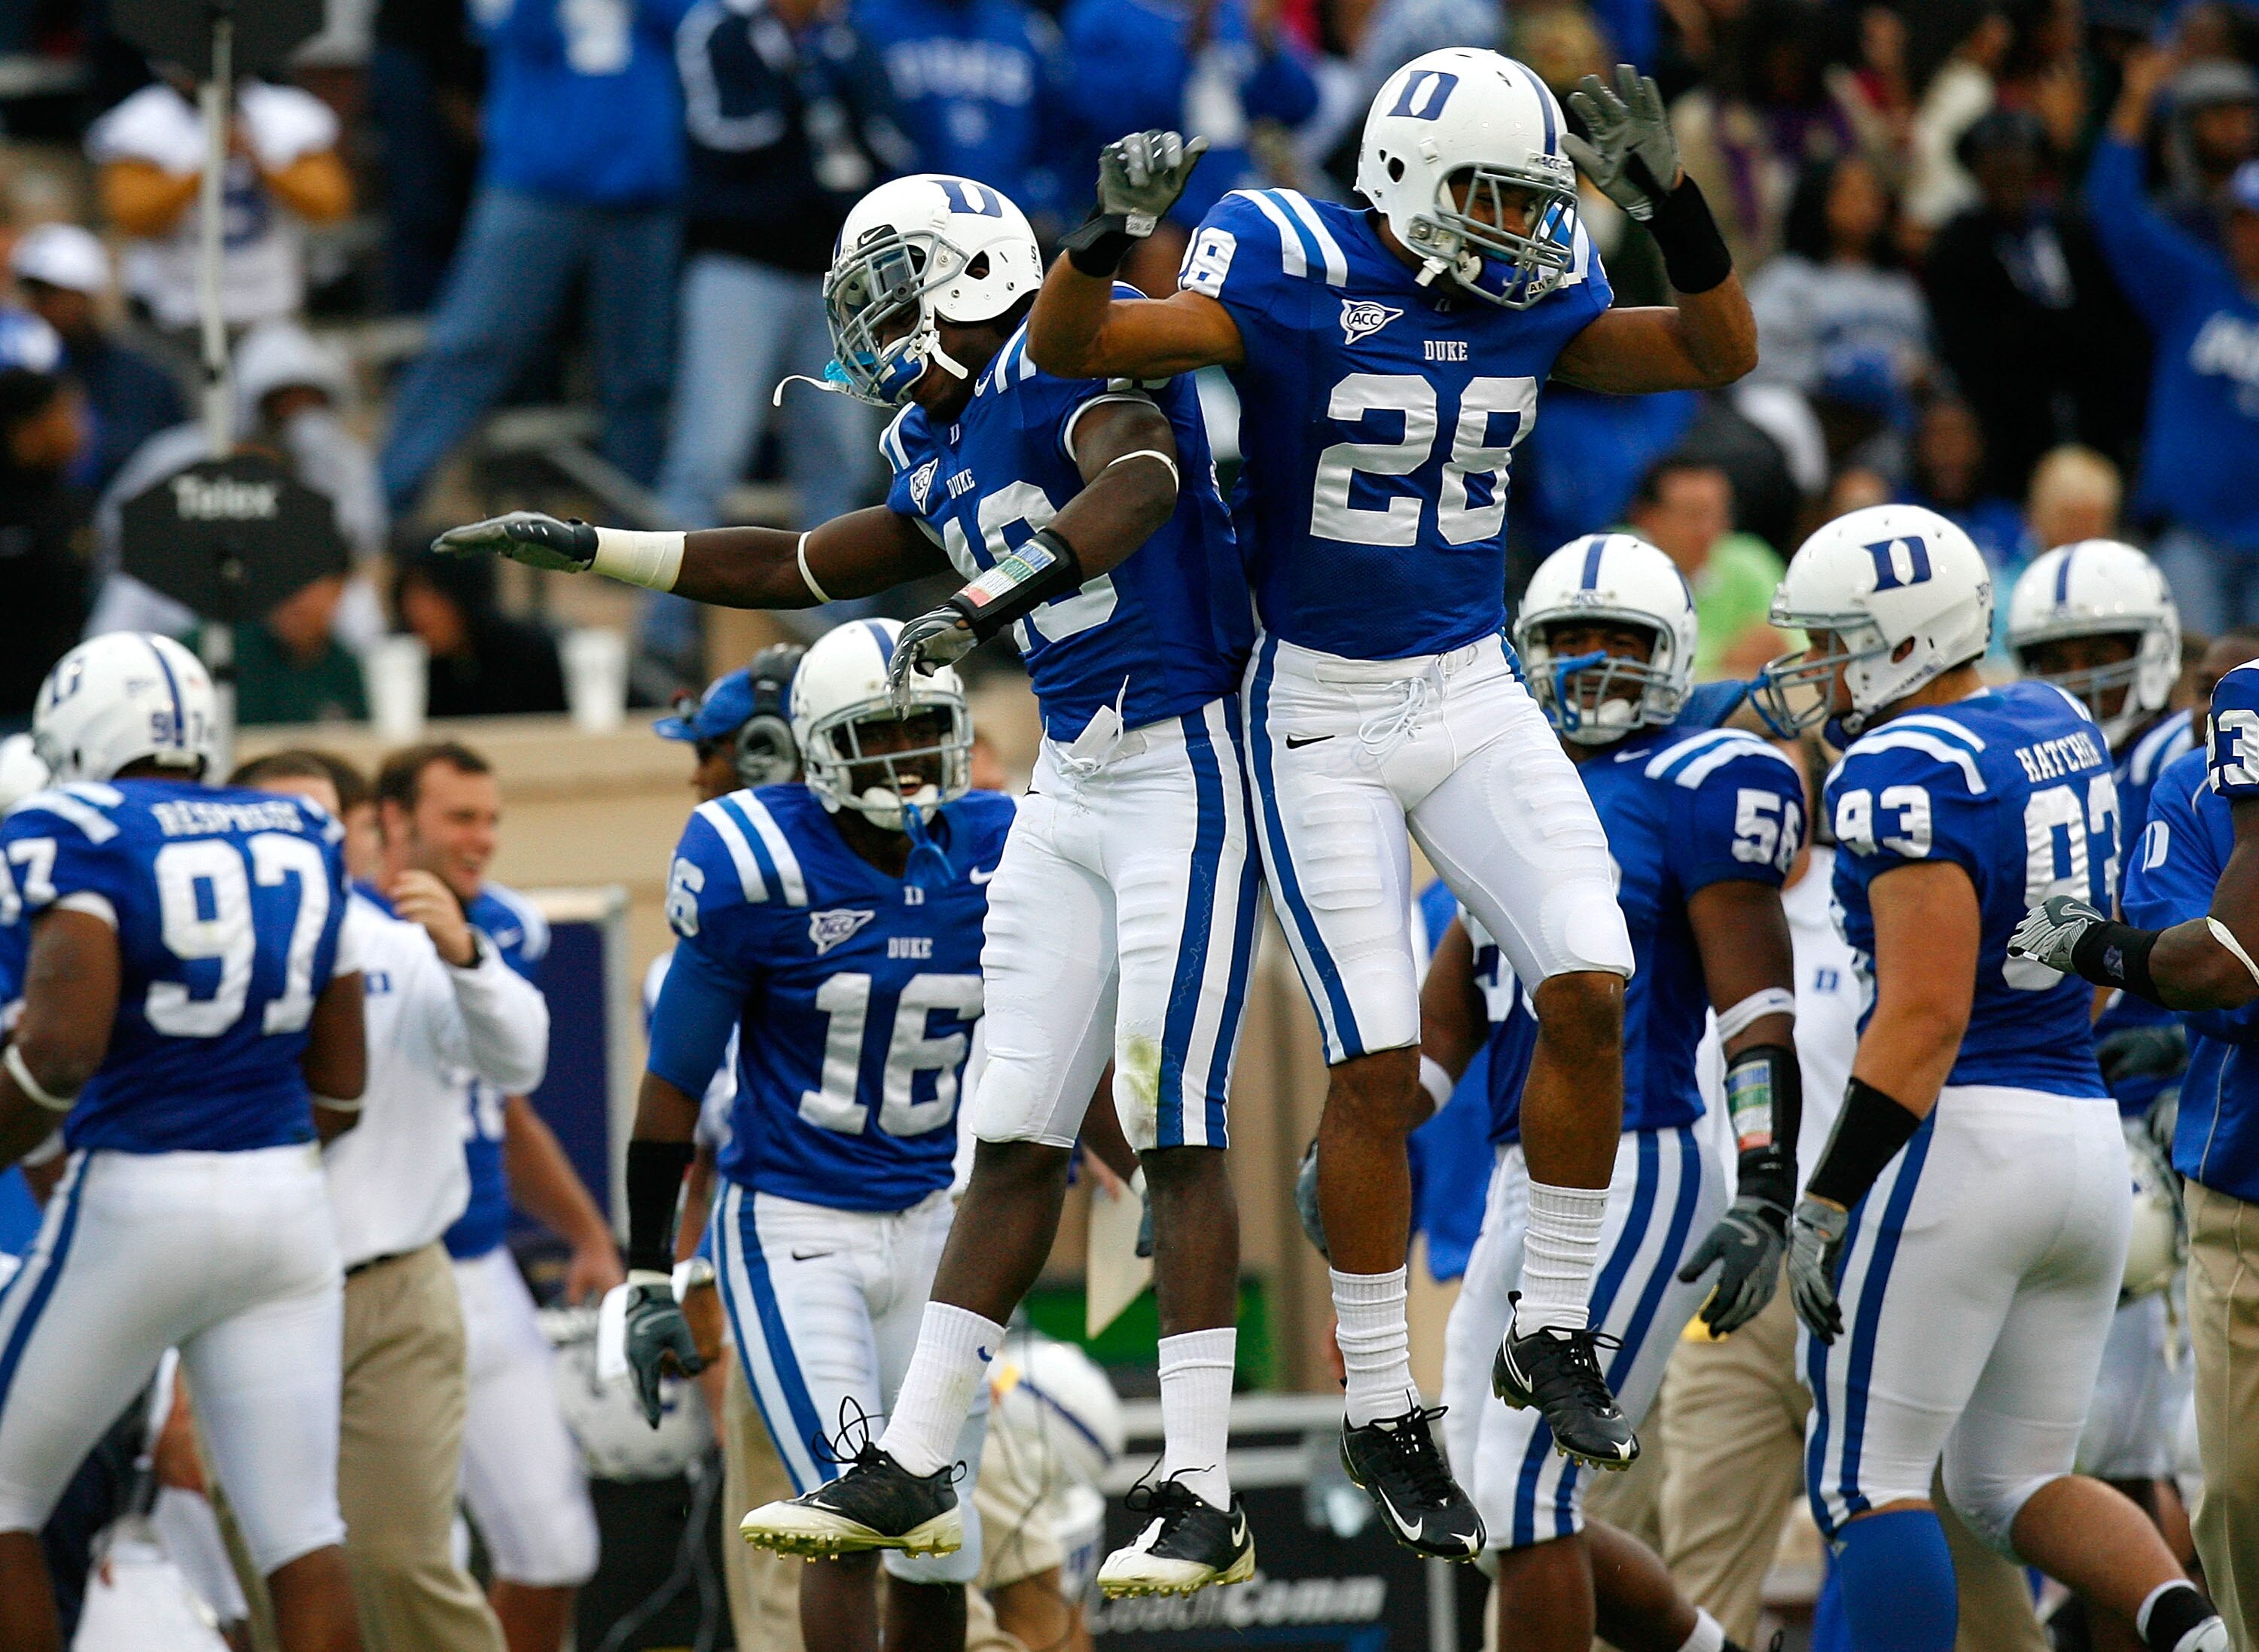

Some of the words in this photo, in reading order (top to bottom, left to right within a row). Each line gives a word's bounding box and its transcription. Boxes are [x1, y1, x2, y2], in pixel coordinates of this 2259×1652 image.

[1386, 70, 1459, 121] D
[925, 179, 1003, 218] D
[1177, 226, 1237, 299] 8
[1349, 313, 1380, 326] ACC
[1424, 340, 1468, 361] DUKE
[946, 468, 976, 500] DUKE
[1310, 373, 1538, 547] 28
[1861, 535, 1932, 593] D
[1835, 785, 1932, 858] 93
[664, 849, 706, 937] 6
[143, 832, 330, 1038] 97
[887, 937, 934, 959] DUKE
[798, 971, 984, 1137] 16
